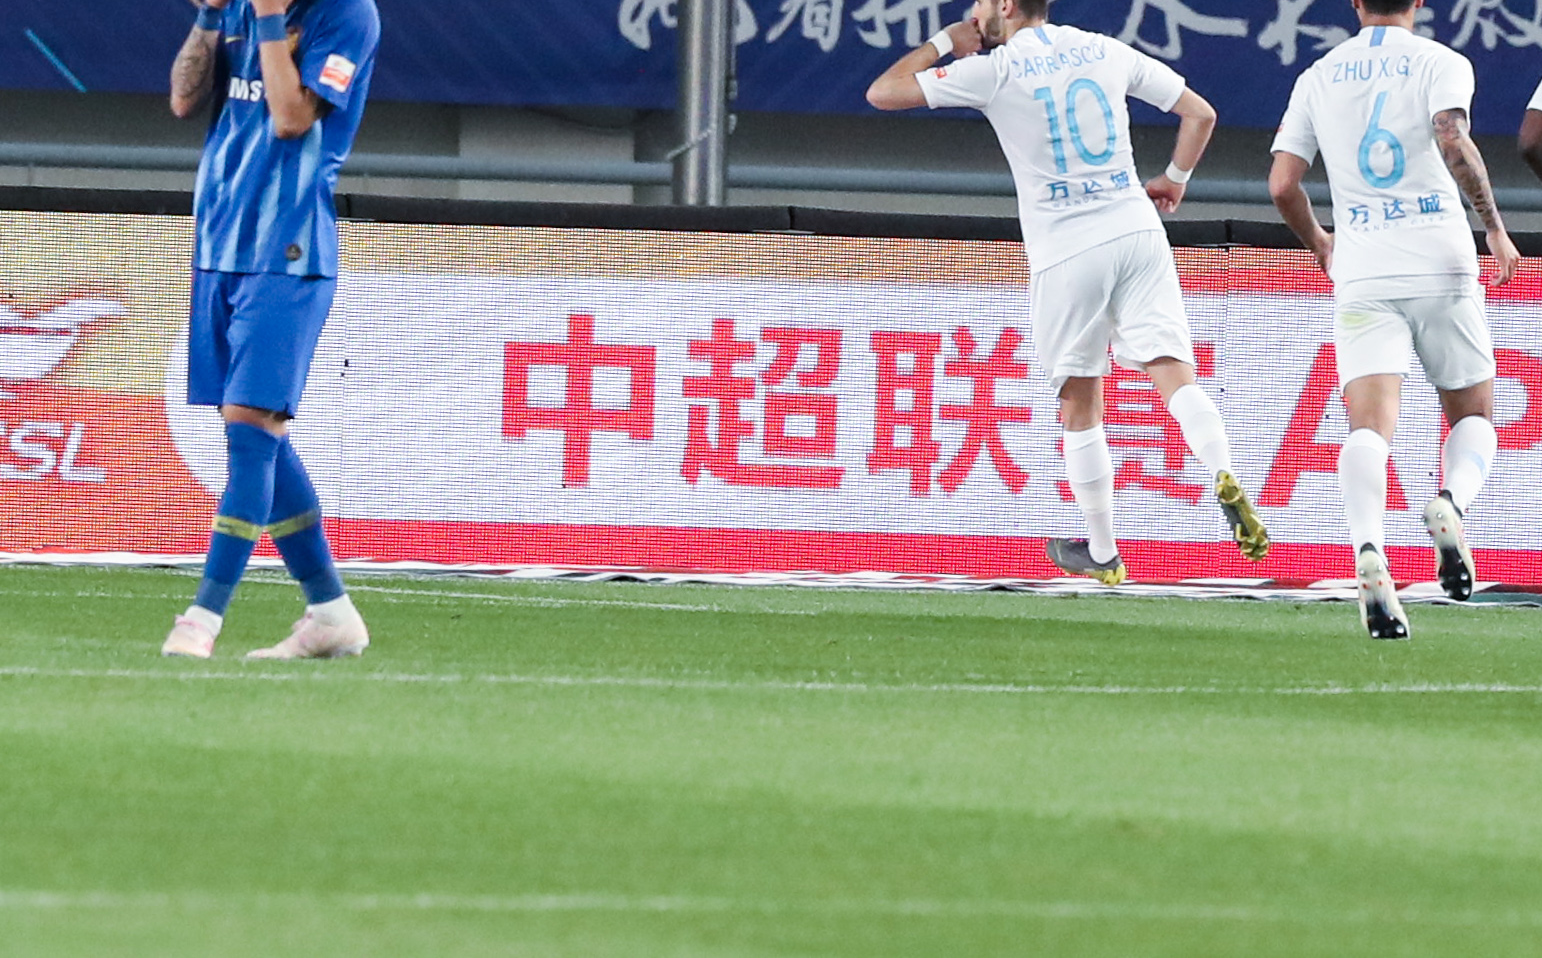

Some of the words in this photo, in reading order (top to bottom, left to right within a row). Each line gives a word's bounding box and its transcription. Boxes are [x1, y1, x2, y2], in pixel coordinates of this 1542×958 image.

[1011, 42, 1106, 80] CARRASCO
[1332, 58, 1373, 84] ZHU
[1034, 78, 1117, 174] 10
[1358, 90, 1405, 189] 6
[1347, 194, 1448, 225] 万达城
[0, 420, 107, 484] SL
